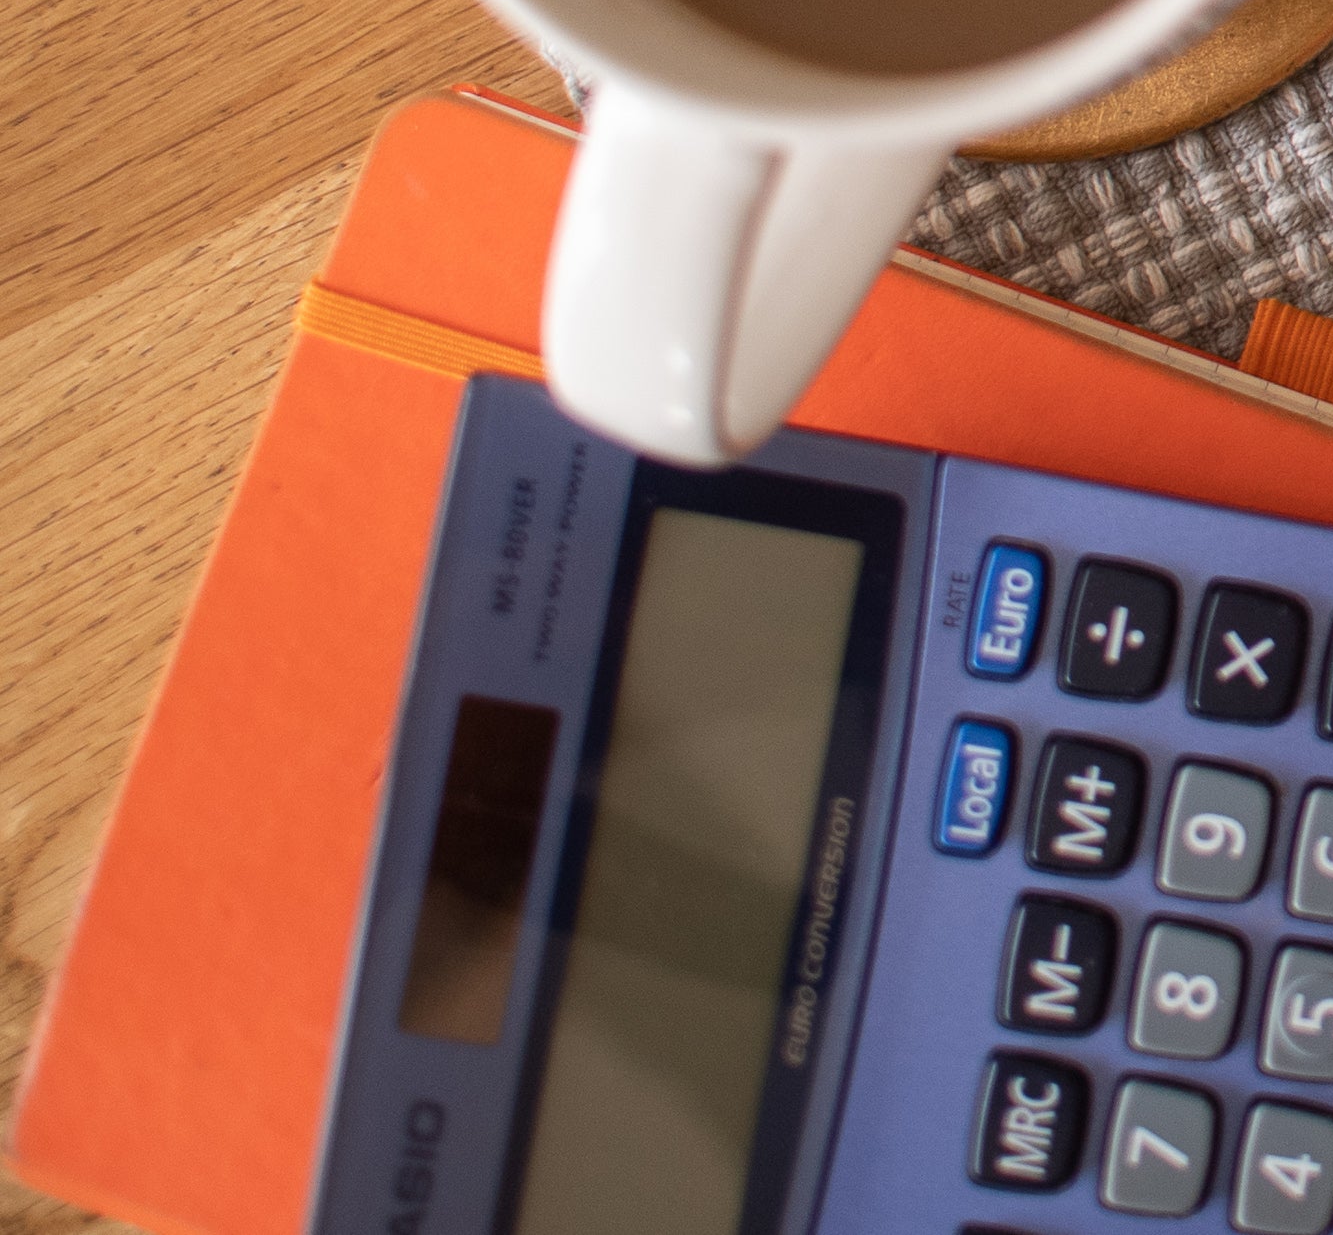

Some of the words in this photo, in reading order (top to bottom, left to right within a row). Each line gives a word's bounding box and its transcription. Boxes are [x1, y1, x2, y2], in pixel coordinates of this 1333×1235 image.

[943, 572, 973, 630] RATE
[980, 567, 1035, 662] Euro
[947, 743, 1003, 843] Local
[1051, 765, 1116, 863] M+
[1183, 811, 1248, 861] 9
[1155, 970, 1219, 1021] 8
[994, 1075, 1061, 1182] MRC
[1125, 1124, 1190, 1171] 7
[1259, 1152, 1322, 1202] 4
